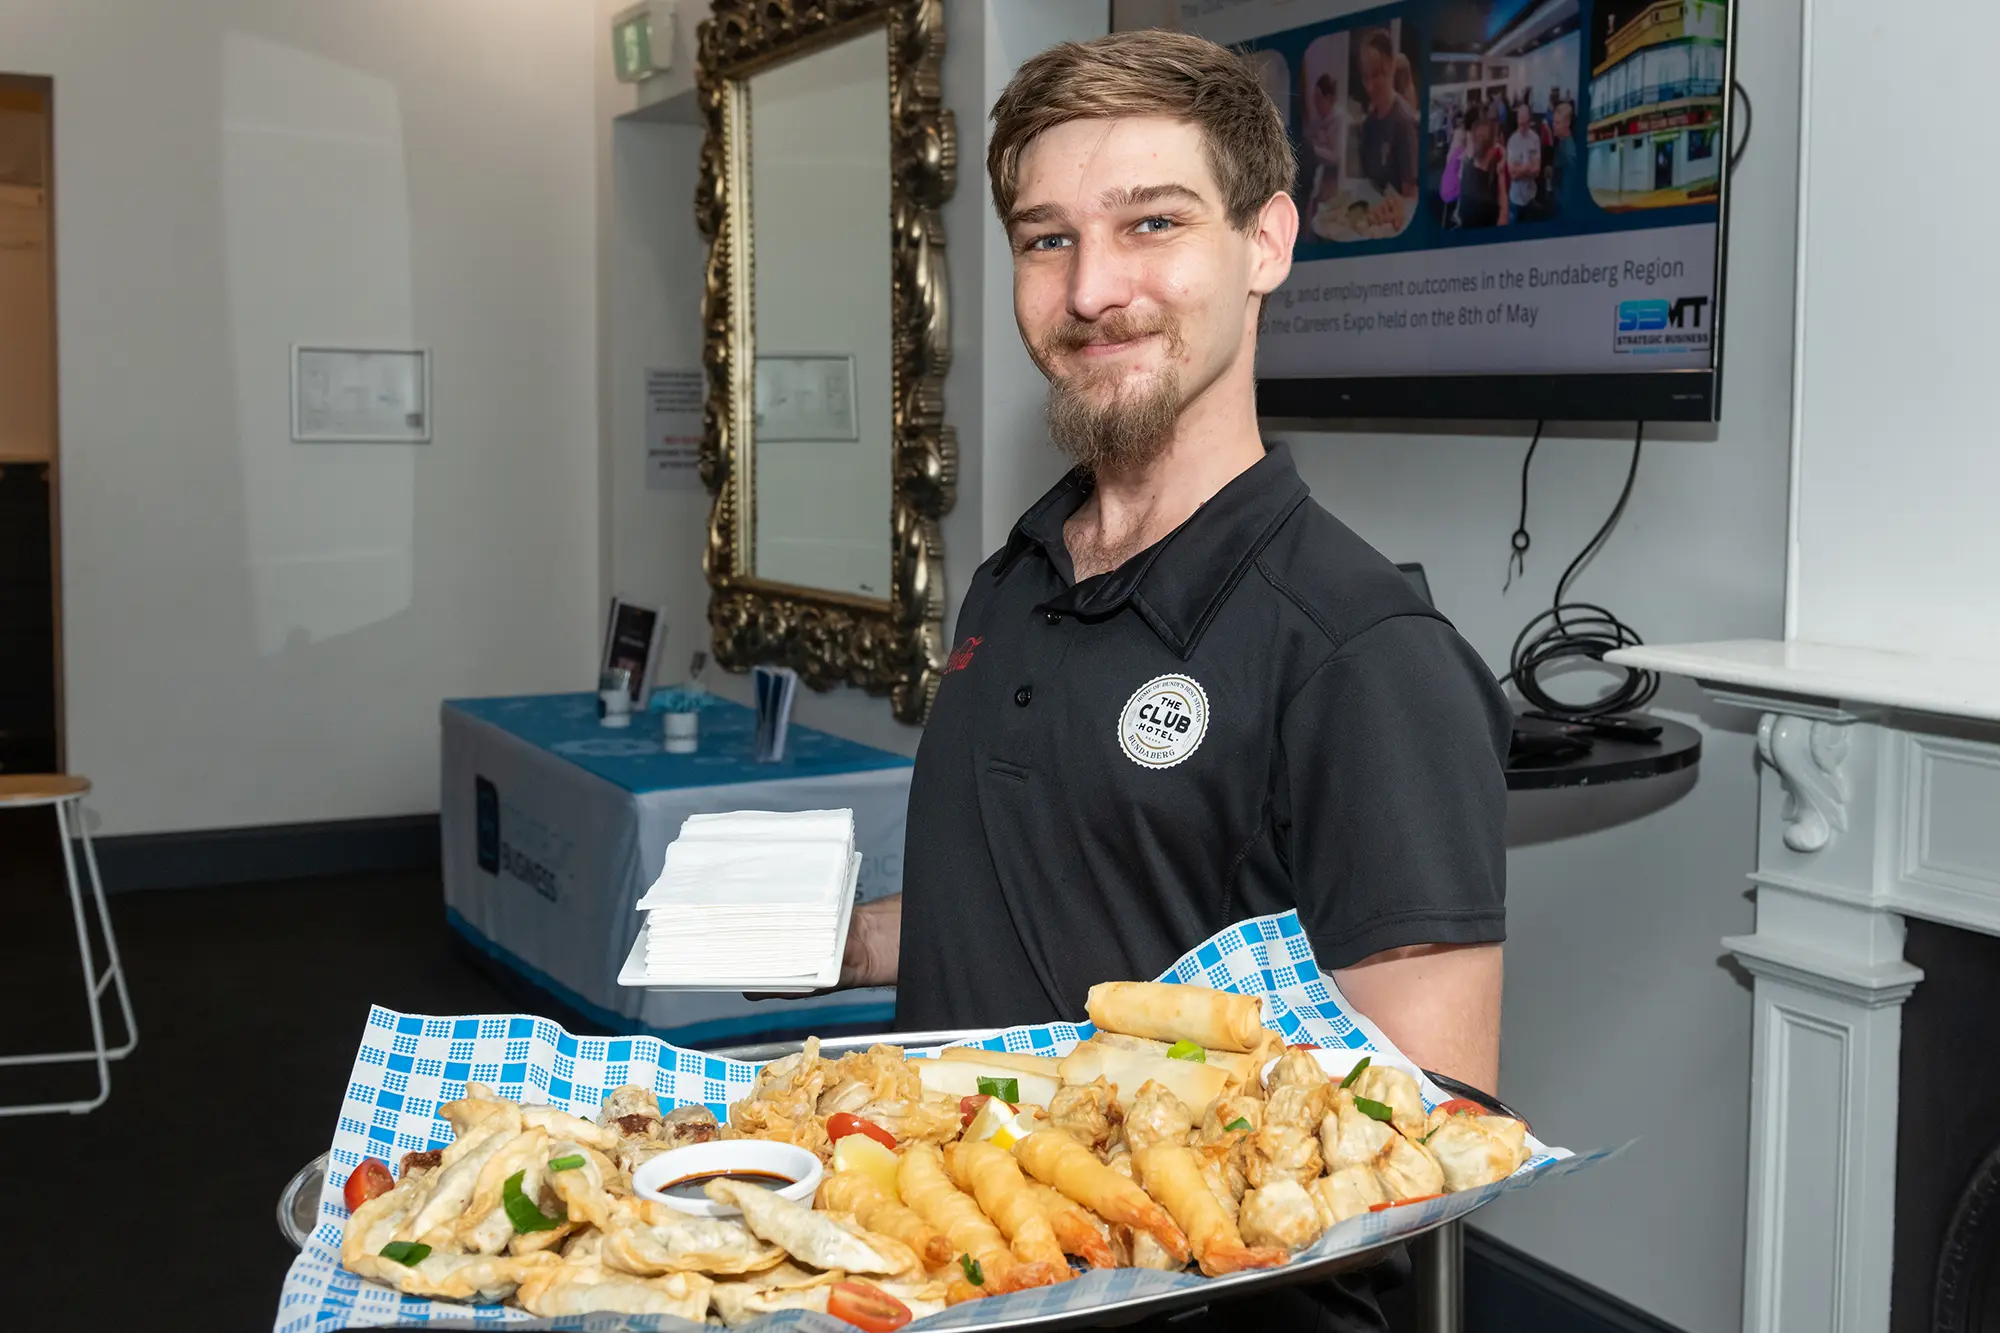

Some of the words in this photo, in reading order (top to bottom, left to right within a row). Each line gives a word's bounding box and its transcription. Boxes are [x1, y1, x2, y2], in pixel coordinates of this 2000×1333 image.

[1322, 279, 1404, 304] employment
[1408, 275, 1477, 296] outcomes
[1482, 270, 1495, 289] in
[1500, 268, 1523, 289] the
[1529, 263, 1618, 287] Bundaberg
[1624, 256, 1684, 285] Region
[1293, 314, 1340, 333] Careers
[1344, 312, 1375, 335] Expo
[1378, 309, 1407, 330] held
[1411, 312, 1428, 328] on
[1432, 306, 1455, 326] the
[1458, 305, 1482, 326] 8th
[1487, 303, 1503, 324] of
[1507, 303, 1539, 328] May
[1617, 334, 1663, 346] STRATEGIC
[1665, 332, 1709, 344] BUSINESS
[1160, 696, 1182, 711] THE
[1139, 703, 1192, 734] CLUB
[1138, 722, 1174, 742] HOTEL
[1127, 734, 1176, 760] BUNDABERG
